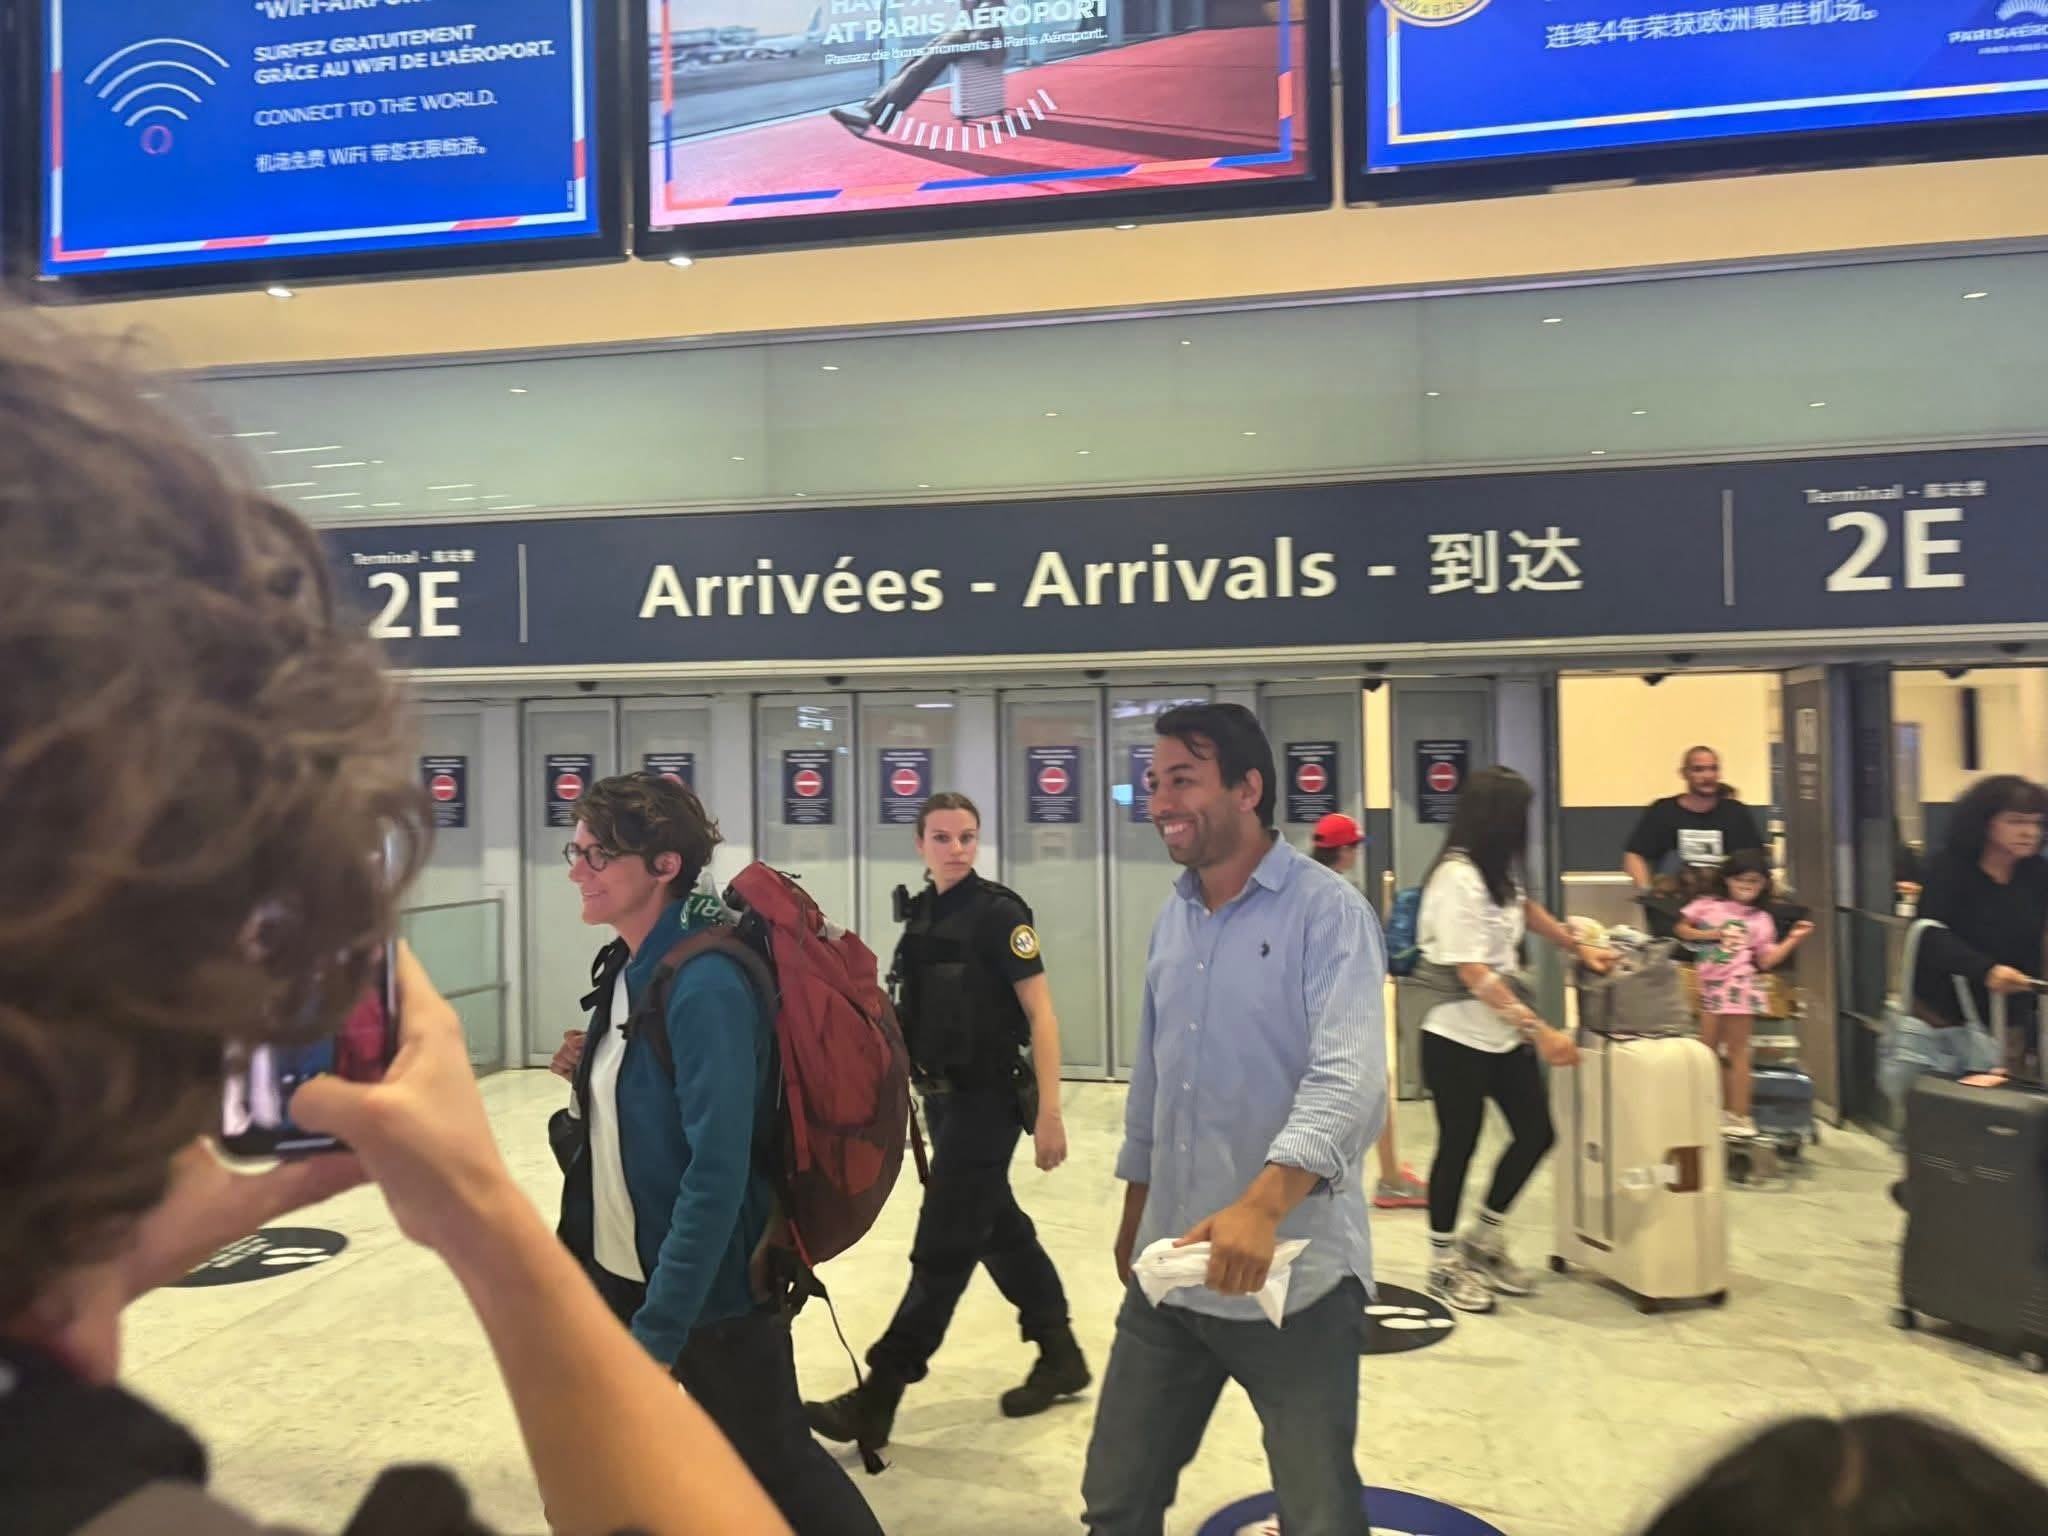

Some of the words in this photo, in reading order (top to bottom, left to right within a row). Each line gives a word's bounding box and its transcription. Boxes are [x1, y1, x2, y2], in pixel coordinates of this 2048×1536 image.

[254, 40, 328, 62] SURFEZ
[329, 24, 477, 54] GRATUITEMENT
[822, 21, 861, 45] AT
[864, 13, 946, 41] PARIS
[951, 0, 1107, 33] AÉROPORT
[254, 62, 319, 84] GRÂCE
[321, 60, 350, 78] AU
[352, 55, 397, 74] WIFI
[399, 53, 429, 69] DE
[430, 40, 556, 68] L'AÉROPORT.
[872, 49, 891, 60] de
[991, 36, 1003, 49] à
[1003, 35, 1038, 48] Paris
[254, 102, 346, 126] CONNECT
[350, 100, 376, 117] TO
[378, 97, 417, 114] THE
[419, 89, 498, 111] WORLD.
[639, 556, 945, 618] Arrivées
[969, 582, 997, 593] -
[1022, 536, 1338, 607] Arrivals
[1366, 565, 1397, 577] -
[1427, 526, 1585, 595] 到达
[1826, 508, 1966, 592] 2E
[368, 570, 462, 640] 2E
